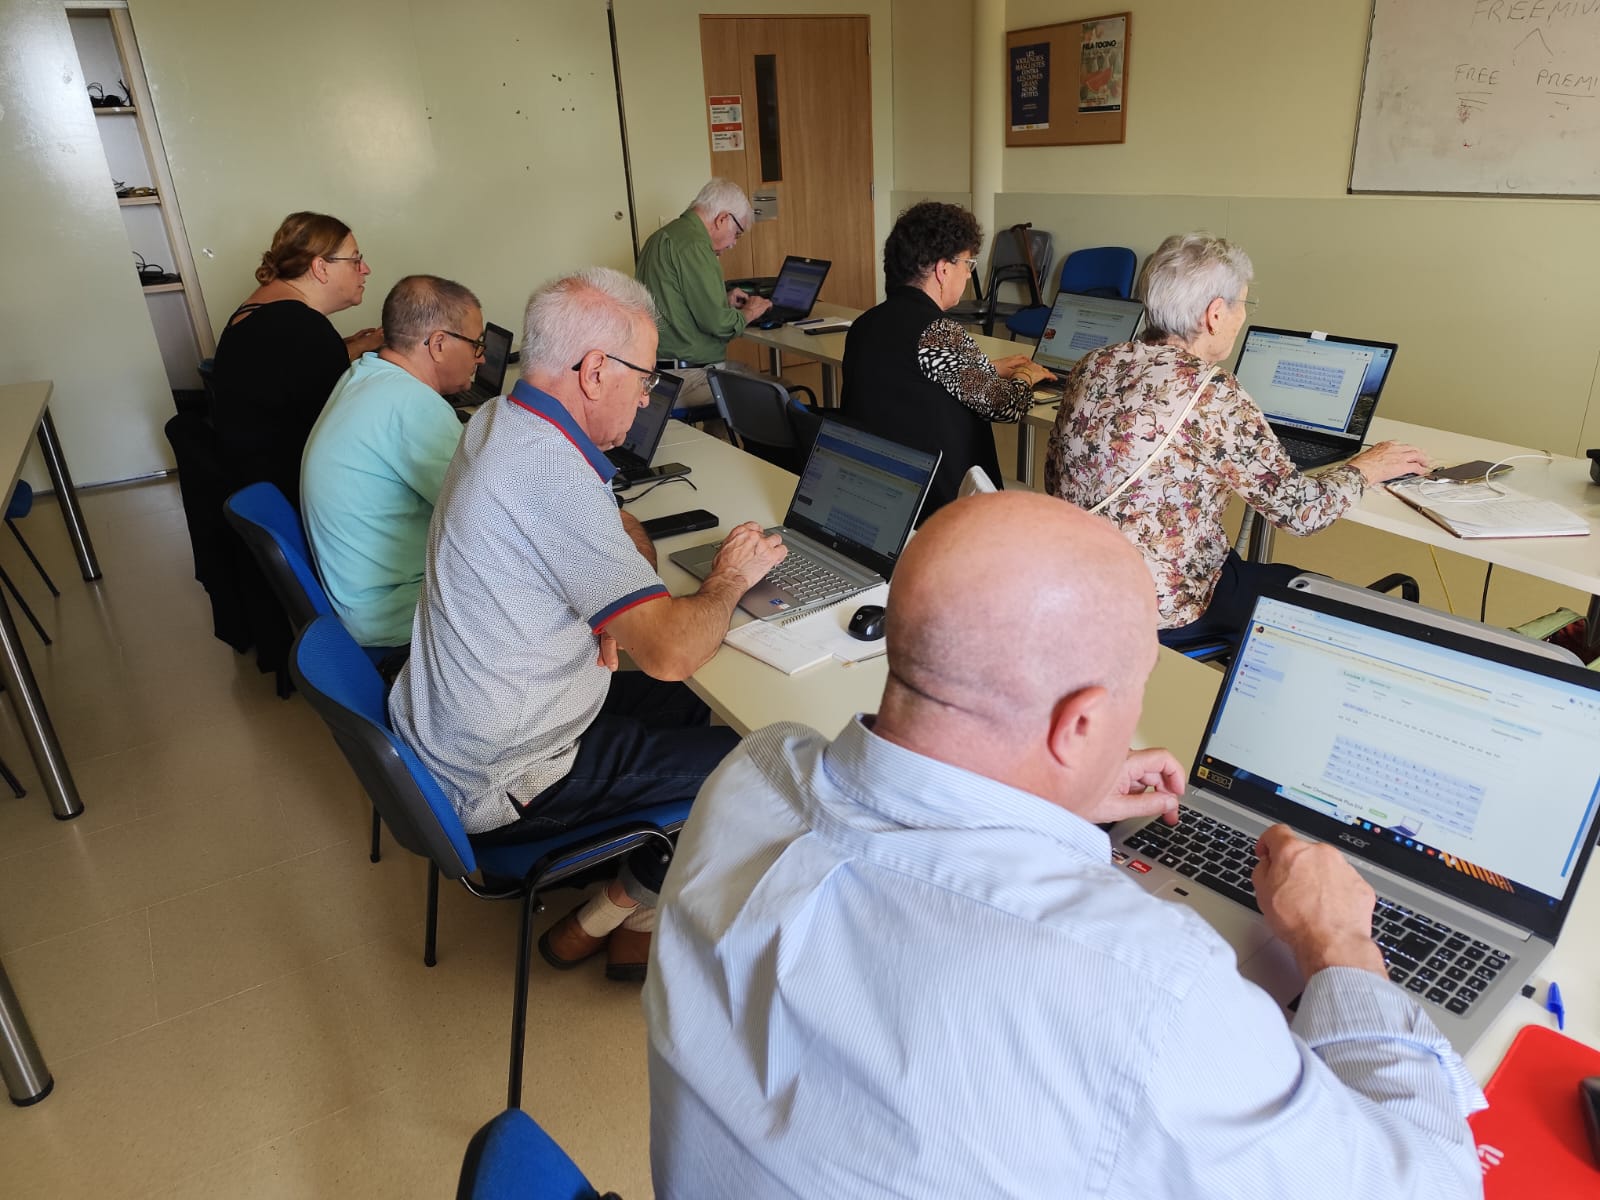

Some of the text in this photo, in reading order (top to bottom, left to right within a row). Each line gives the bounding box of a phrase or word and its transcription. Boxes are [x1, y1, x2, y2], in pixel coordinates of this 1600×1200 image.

[1471, 0, 1600, 24] FREEMIU
[1455, 63, 1500, 85] FREE
[1338, 832, 1371, 849] acer
